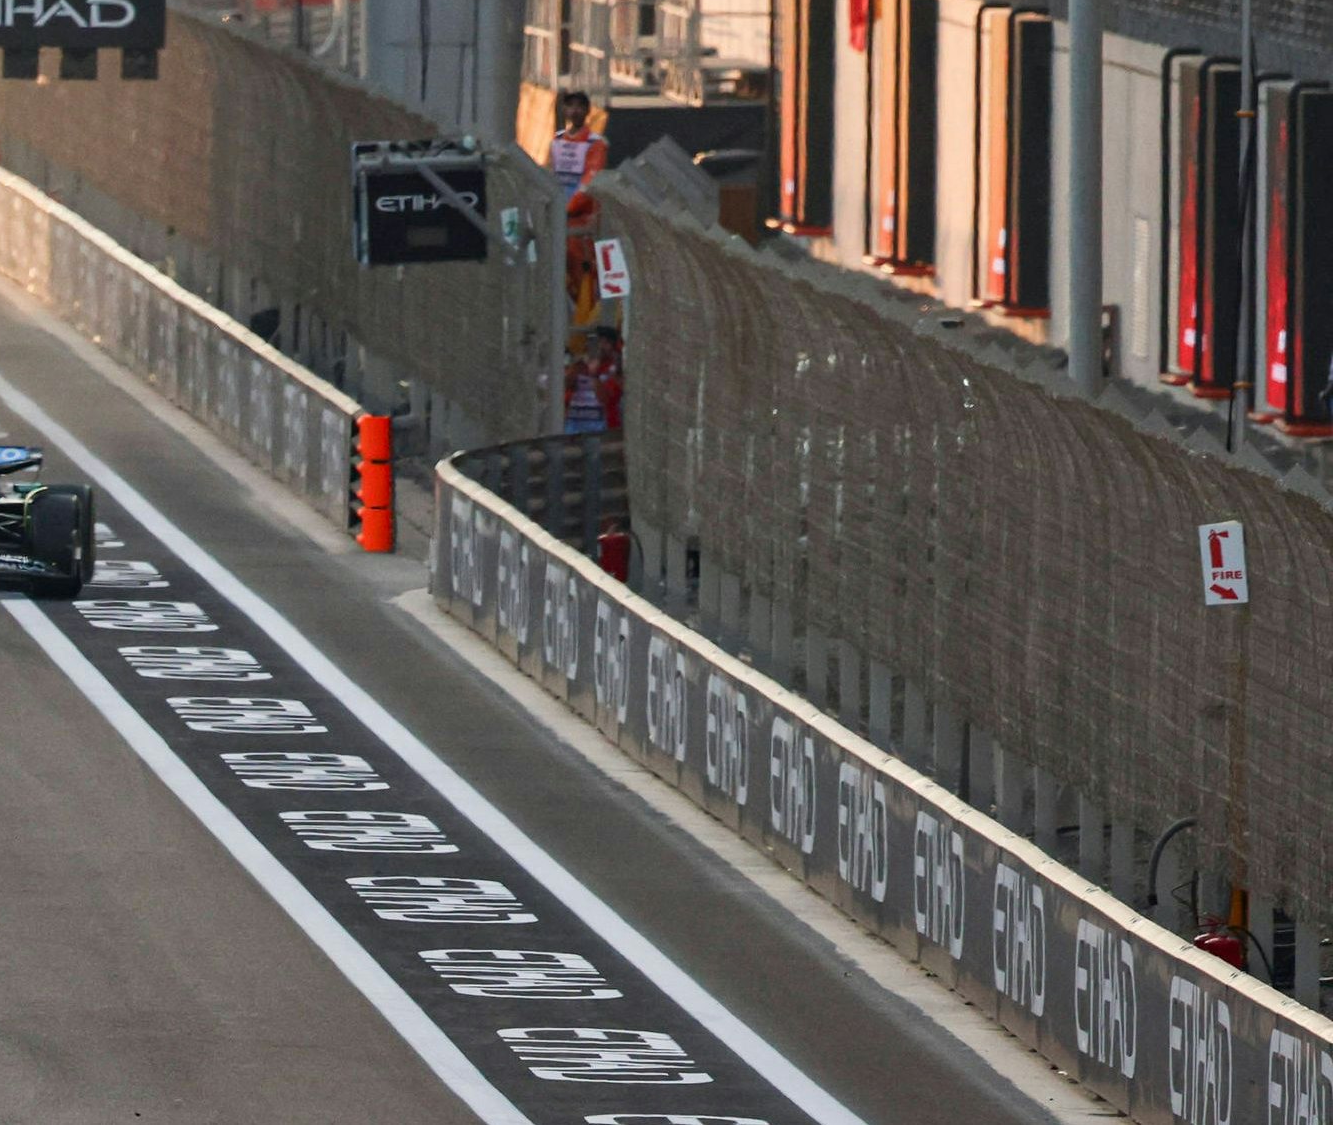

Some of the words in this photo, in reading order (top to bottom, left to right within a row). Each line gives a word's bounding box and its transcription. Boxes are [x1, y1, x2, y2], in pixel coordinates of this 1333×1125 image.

[1211, 570, 1243, 581] FIRE
[915, 810, 964, 960] ETIHAD
[993, 863, 1045, 1017] ETIHAD
[1075, 918, 1136, 1079] ETIHAD
[1169, 975, 1233, 1125] ETIHAD
